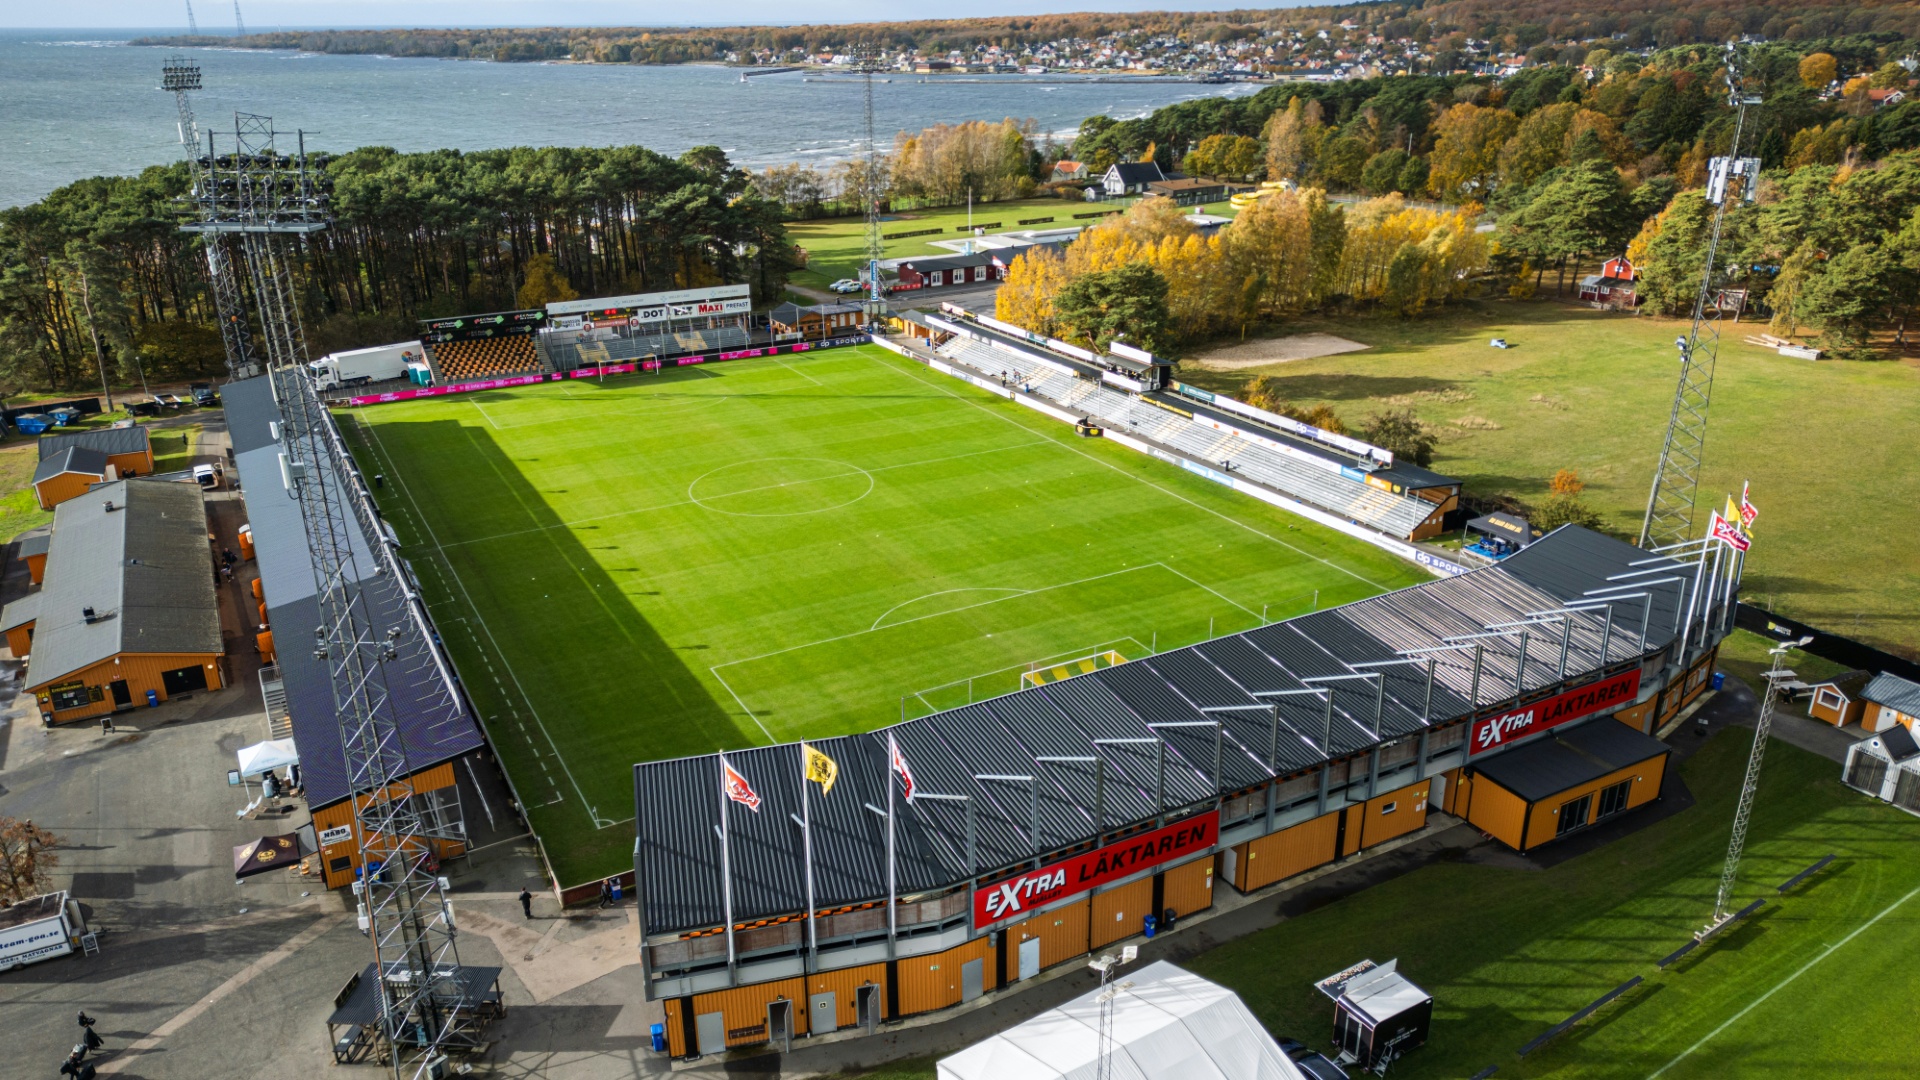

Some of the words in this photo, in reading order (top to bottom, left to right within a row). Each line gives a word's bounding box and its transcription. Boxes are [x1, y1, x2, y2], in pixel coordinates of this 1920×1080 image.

[698, 304, 723, 313] MAXI
[726, 301, 748, 309] PREFAST
[641, 309, 664, 319] .DOT
[408, 354, 423, 362] NEP
[1417, 551, 1431, 564] dp
[1478, 710, 1534, 748] EXTRA
[1541, 679, 1632, 723] LÄKTAREN
[985, 868, 1066, 919] EXTRA
[1078, 823, 1208, 883] LÄKTAREN
